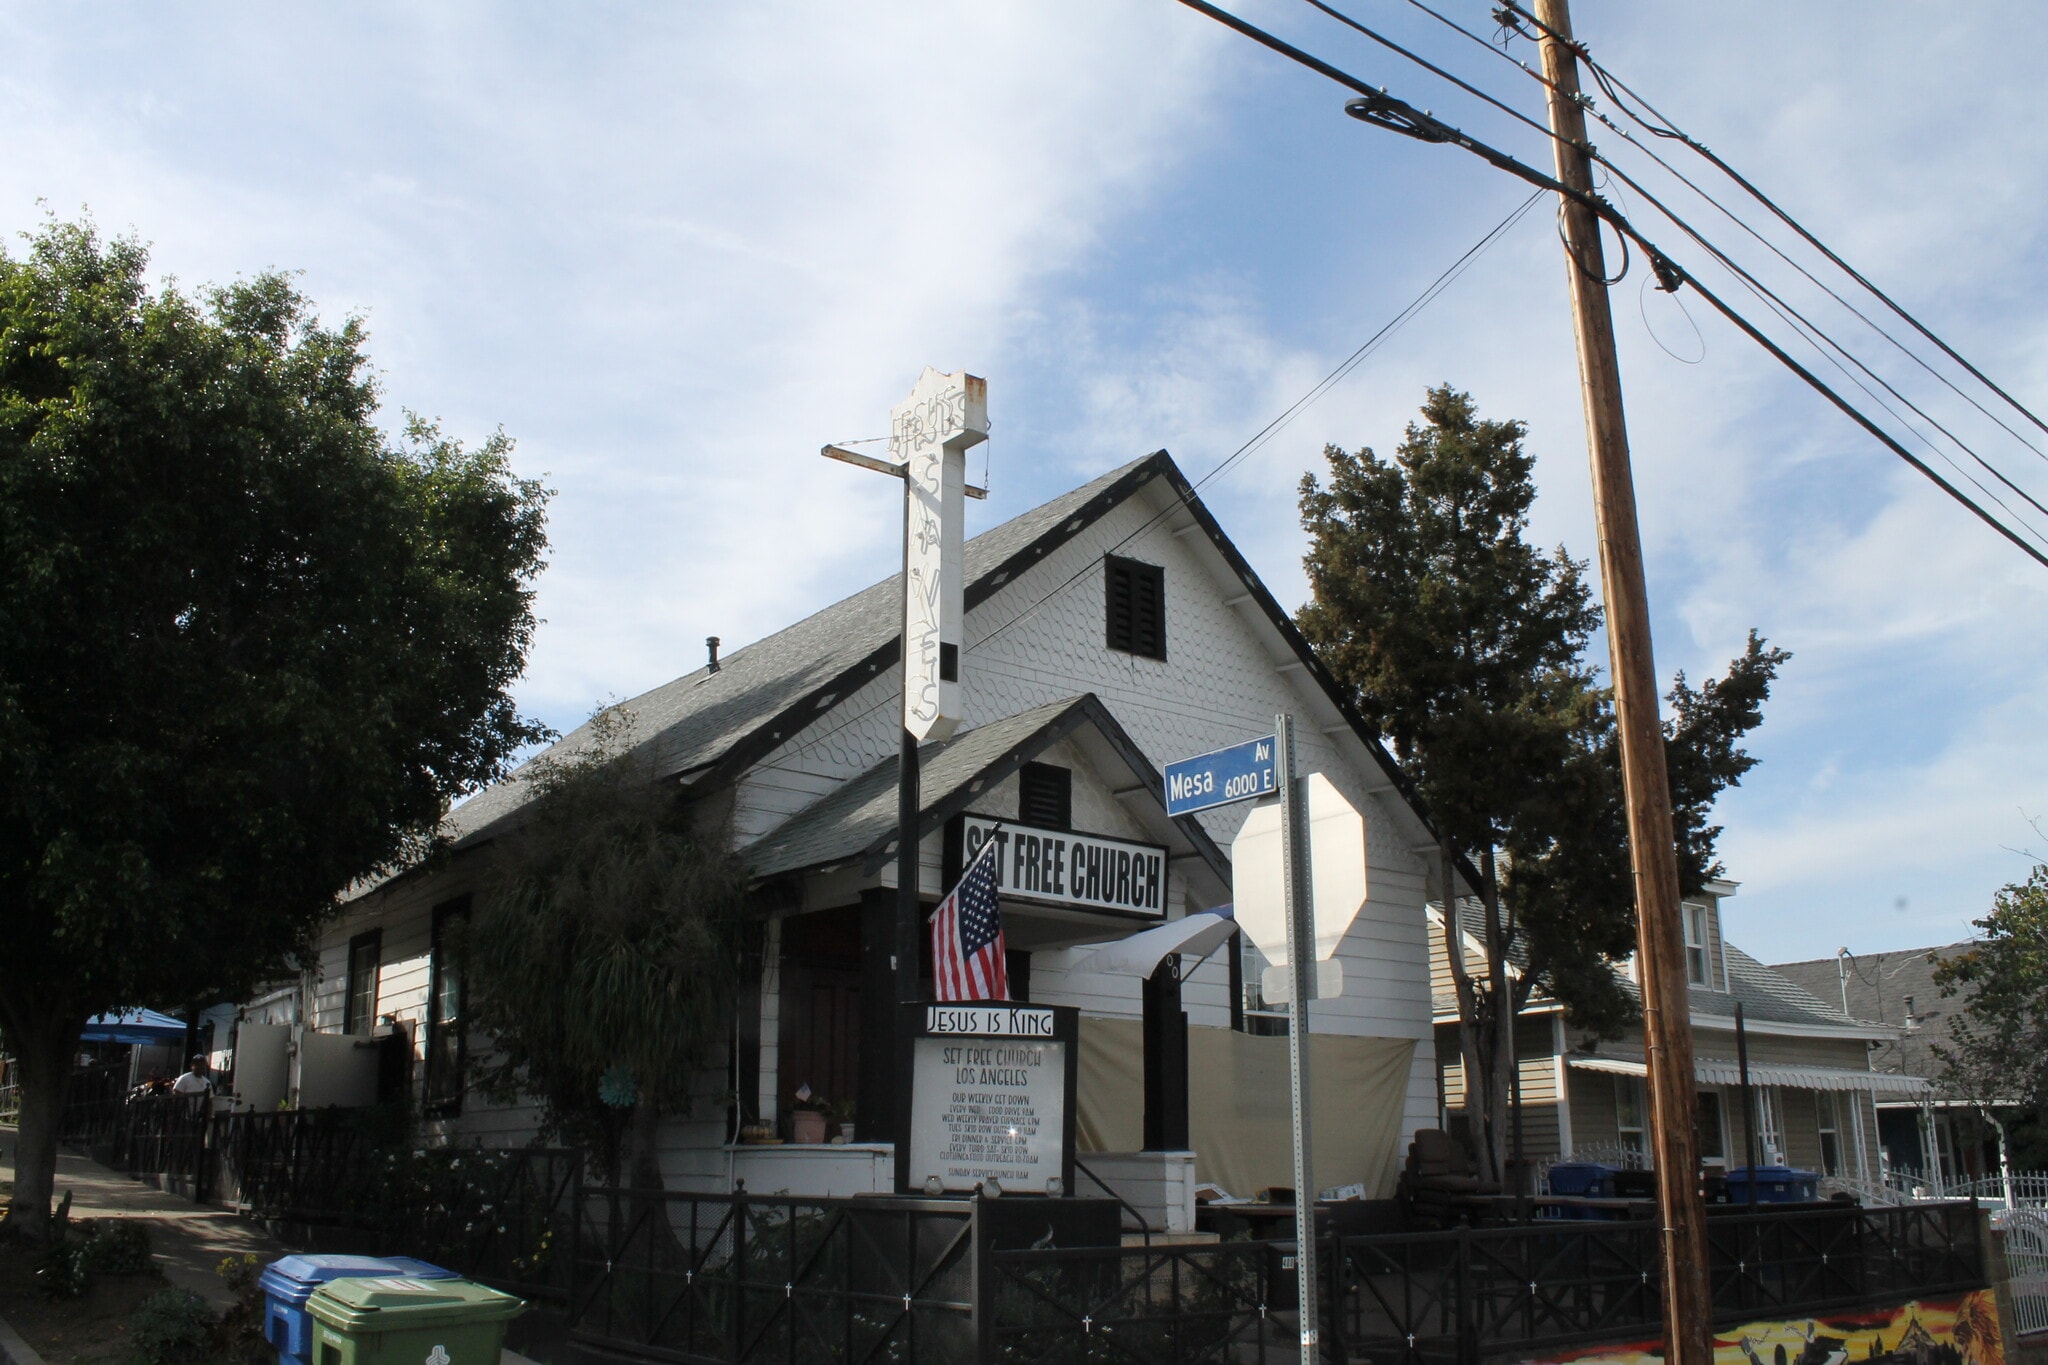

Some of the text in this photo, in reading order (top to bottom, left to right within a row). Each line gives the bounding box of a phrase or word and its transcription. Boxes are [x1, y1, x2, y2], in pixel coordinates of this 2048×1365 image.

[1170, 742, 1270, 802] Mesa Av
[1225, 768, 1272, 798] 6000 E
[1013, 833, 1065, 895] FREE
[1070, 842, 1161, 909] CHURCH
[927, 1006, 1052, 1035] JESUS IS KING
[943, 1047, 1041, 1067] SET FREE CHURCH
[956, 1067, 1028, 1086] LOS ANGELES
[952, 1093, 1030, 1106] OUR WEEKLY GET DOWN
